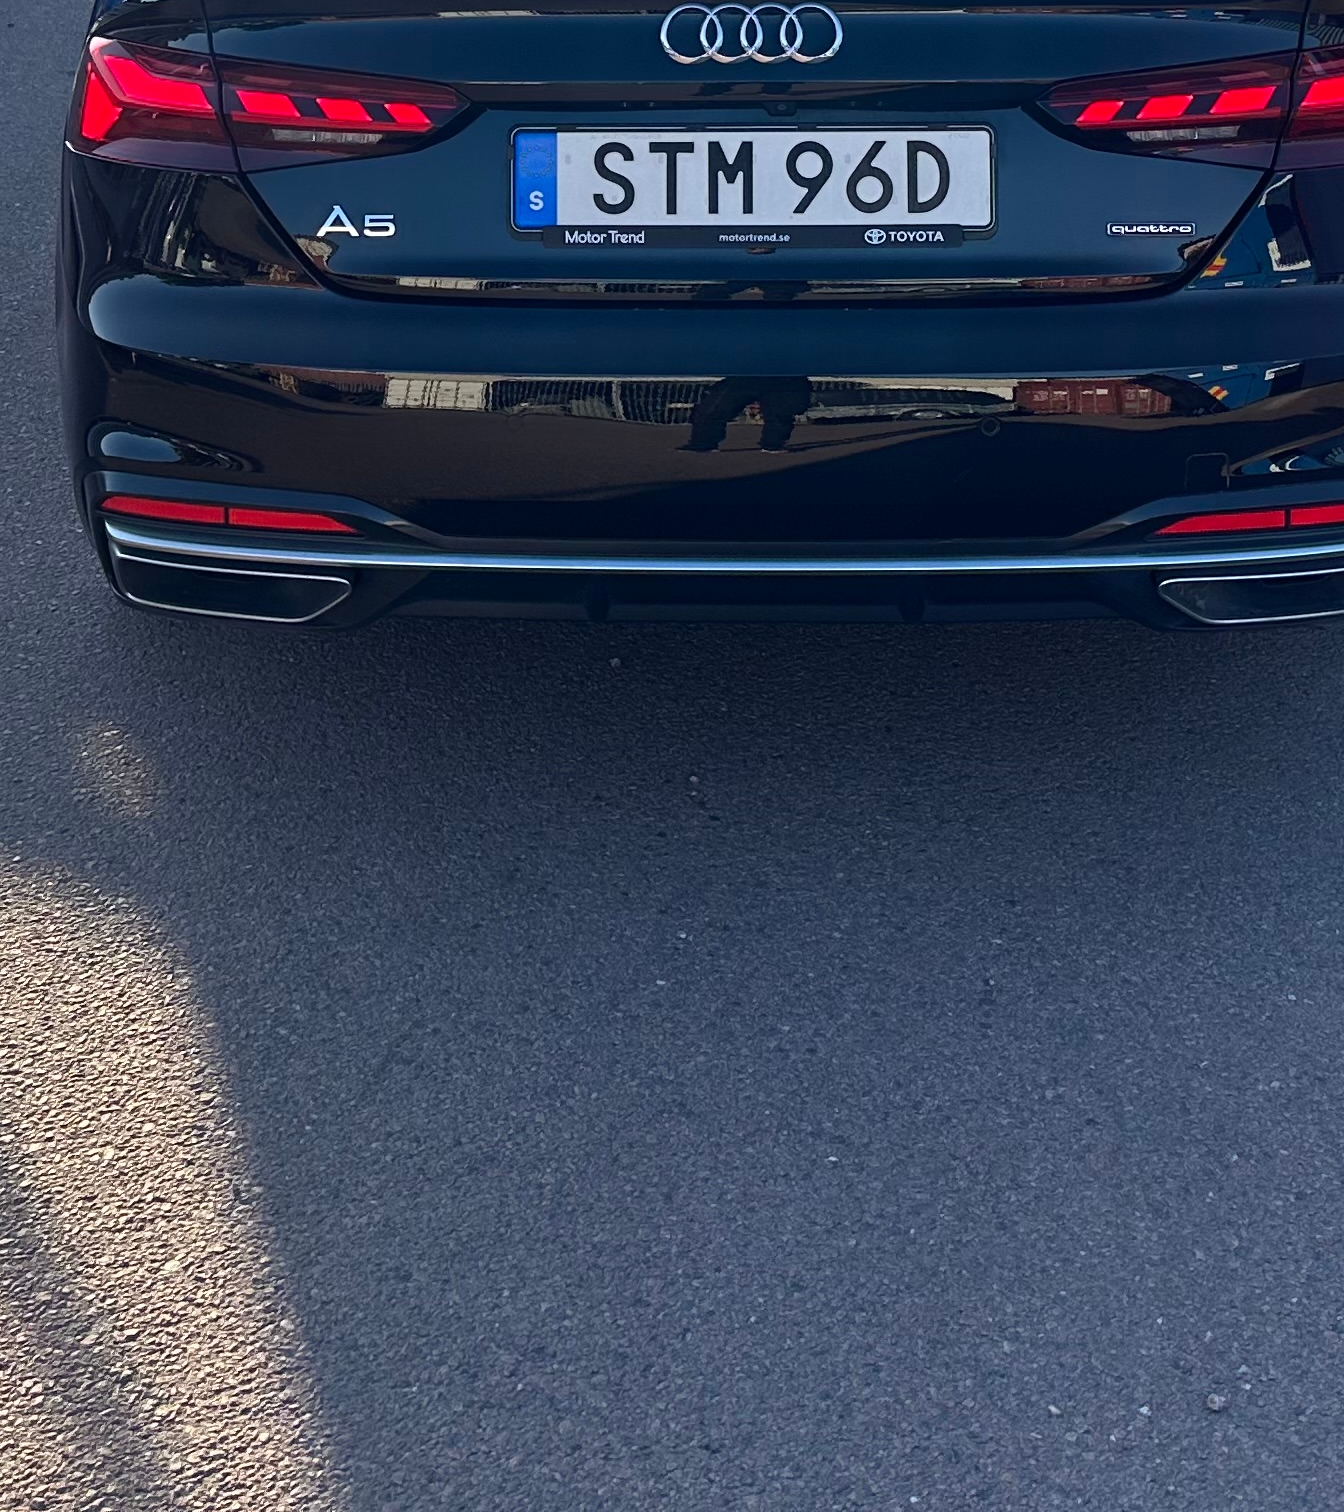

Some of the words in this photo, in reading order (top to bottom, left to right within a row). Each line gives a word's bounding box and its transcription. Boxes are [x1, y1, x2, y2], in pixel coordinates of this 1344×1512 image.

[592, 140, 754, 216] STM
[785, 140, 950, 216] 96D
[529, 190, 545, 211] S
[316, 205, 396, 237] A5
[888, 230, 945, 242] TOYOTA
[1111, 224, 1192, 235] quattro
[564, 230, 607, 244] Motor
[608, 230, 645, 244] Trend
[718, 233, 791, 242] motortrend.se
